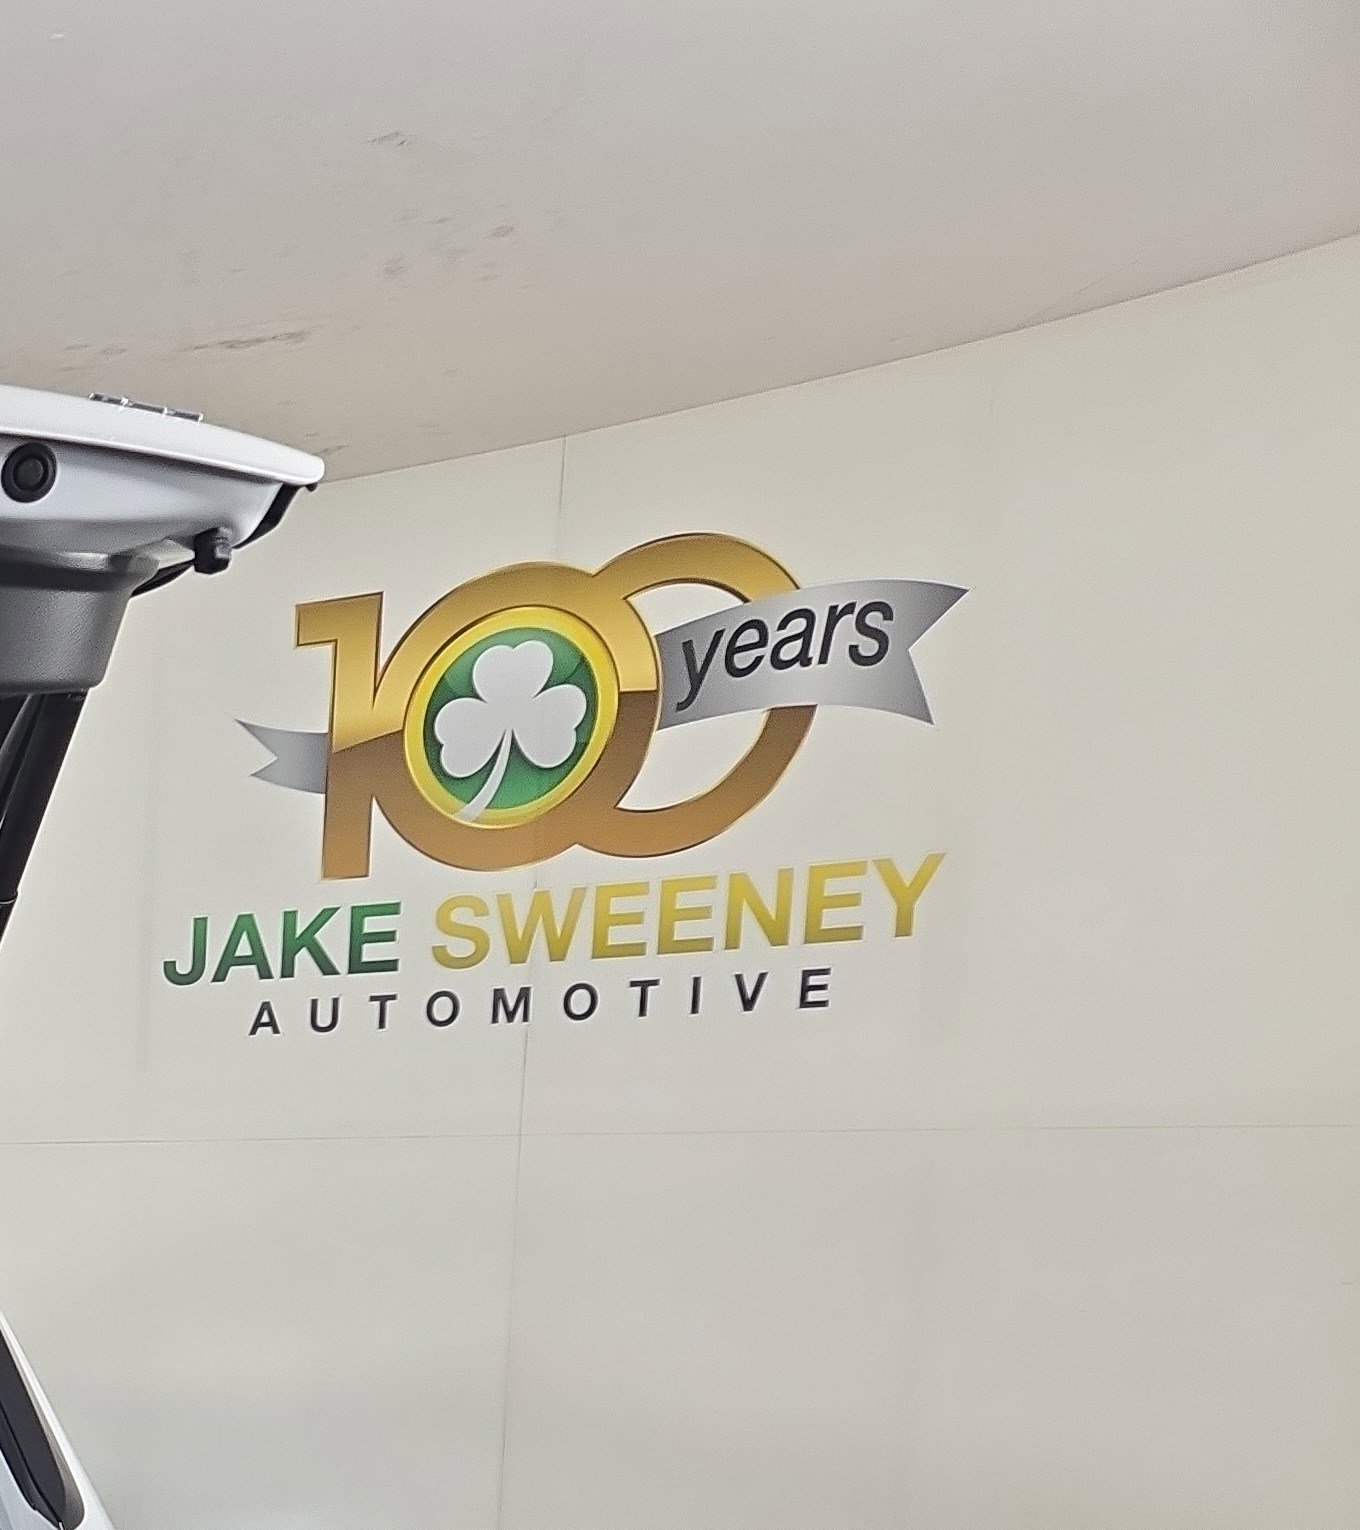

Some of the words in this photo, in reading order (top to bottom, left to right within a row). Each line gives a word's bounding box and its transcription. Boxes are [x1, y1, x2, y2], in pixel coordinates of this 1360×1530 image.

[676, 599, 894, 713] years
[163, 902, 402, 986] JAKE
[431, 853, 947, 969] SWEENEY
[249, 968, 833, 1036] AUTOMOTIVE
